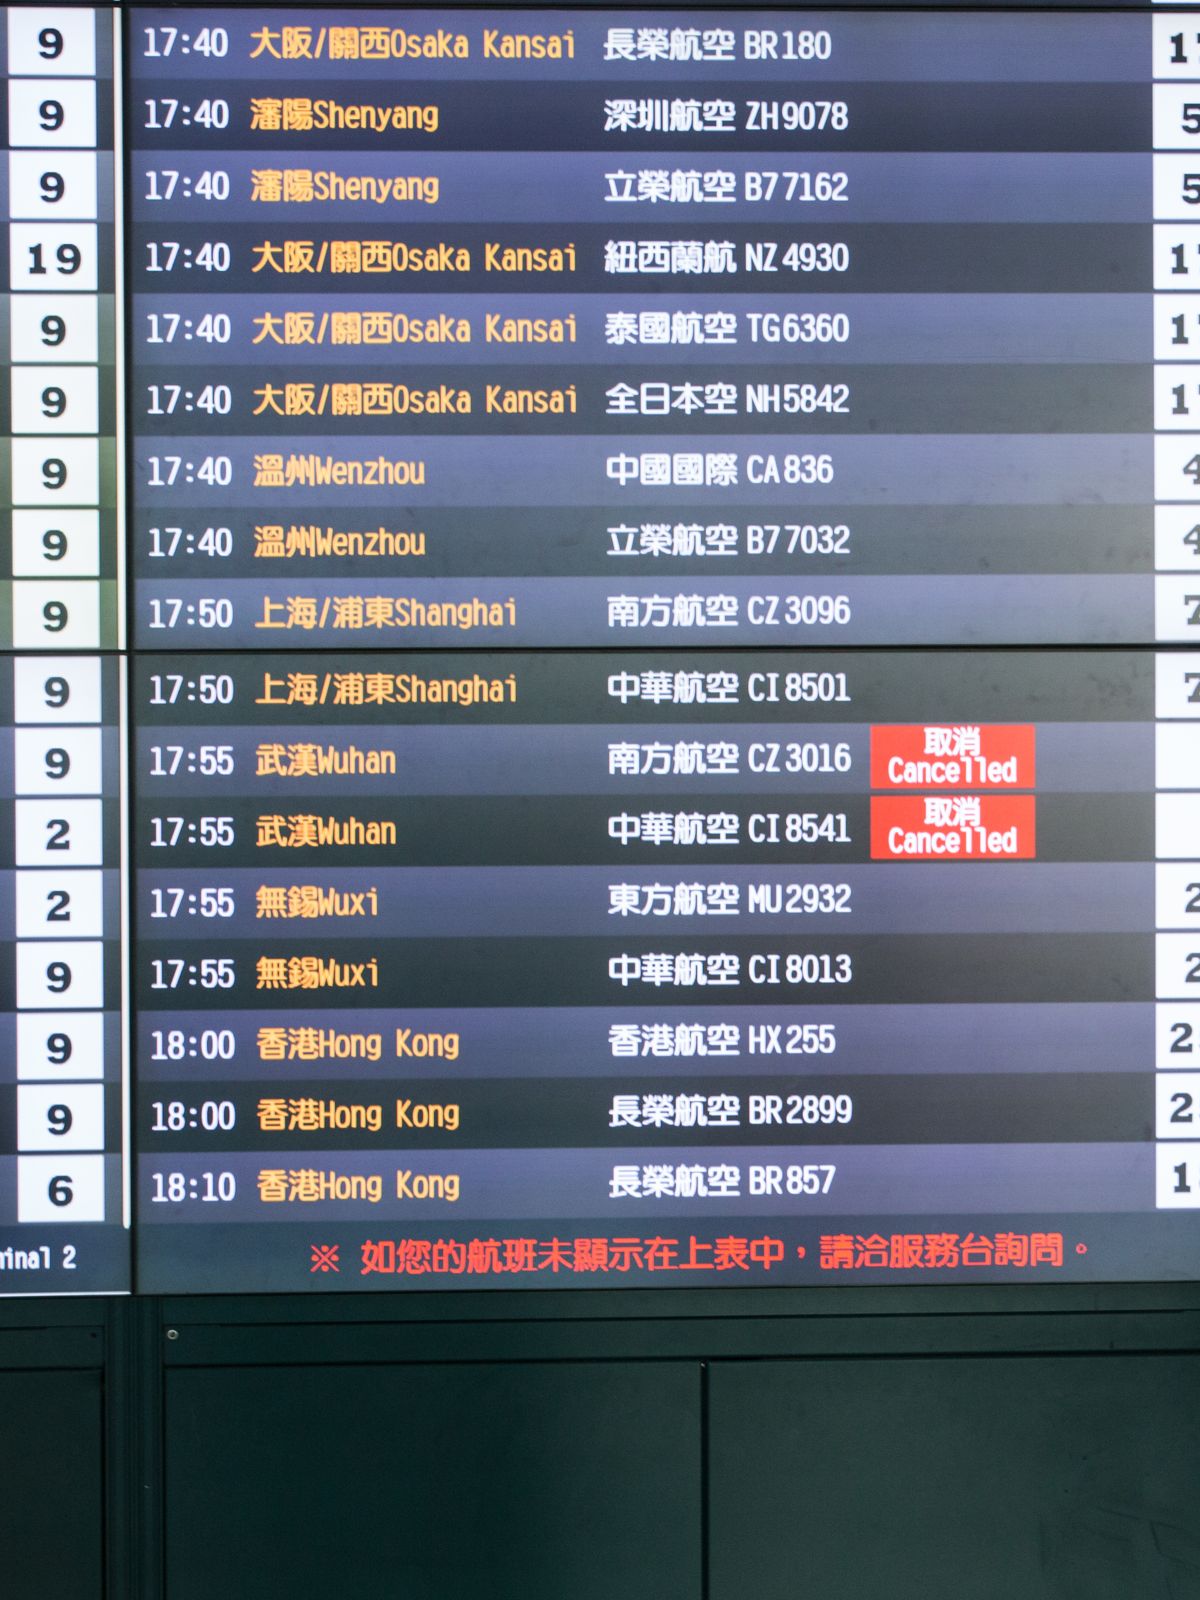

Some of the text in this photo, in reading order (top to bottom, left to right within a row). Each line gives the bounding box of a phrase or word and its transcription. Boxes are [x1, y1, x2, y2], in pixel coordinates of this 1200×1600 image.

[38, 27, 64, 60] 9
[144, 27, 229, 57] 17:40
[483, 30, 574, 59] Kansai
[603, 27, 736, 61] 長榮航空
[39, 99, 64, 131] 9
[145, 99, 229, 129] 17:40
[603, 98, 736, 132] 深圳航空
[40, 171, 65, 203] 9
[145, 170, 230, 201] 17:40
[604, 168, 737, 203] 立榮航空
[29, 243, 82, 275] 19
[146, 242, 231, 272] 17:40
[484, 243, 576, 272] Kansai
[604, 240, 737, 274] 紐西蘭航
[41, 315, 66, 347] 9
[146, 313, 231, 343] 17:40
[485, 314, 576, 343] Kansai
[604, 310, 738, 345] 泰國航空
[41, 386, 67, 418] 9
[147, 384, 232, 414] 17:40
[485, 384, 577, 414] Kansai
[605, 381, 738, 415] 全日本空
[42, 458, 67, 490] 9
[147, 456, 233, 486] 17:40
[606, 452, 739, 487] 中國國際
[42, 529, 68, 561] 9
[148, 527, 233, 557] 17:40
[606, 522, 739, 557] 立榮航空
[43, 601, 68, 632] 9
[149, 598, 234, 628] 17:50
[606, 593, 739, 628] 南方航空
[44, 676, 70, 708] 9
[150, 674, 234, 704] 17:50
[607, 670, 739, 704] 中華航空
[924, 726, 980, 757] 取消
[45, 748, 70, 779] 9
[150, 745, 234, 776] 17:55
[607, 740, 740, 775] 南方航空
[887, 756, 1018, 785] Cancelled
[924, 796, 980, 827] 取消
[46, 819, 70, 850] 2
[150, 816, 235, 847] 17:55
[608, 811, 740, 845] 中華航空
[887, 826, 1018, 855] Cancelled
[46, 890, 71, 922] 2
[150, 887, 235, 918] 17:55
[607, 881, 740, 917] 東方航空
[46, 961, 72, 993] 9
[151, 959, 235, 989] 17:55
[608, 952, 740, 987] 中華航空
[47, 1033, 72, 1065] 9
[151, 1029, 236, 1060] 18:00
[396, 1028, 459, 1060] Kong
[608, 1022, 741, 1057] 香港航空
[47, 1104, 73, 1136] 9
[151, 1101, 235, 1131] 18:00
[396, 1099, 460, 1131] Kong
[608, 1093, 741, 1128] 長榮航空
[48, 1175, 73, 1207] 6
[152, 1171, 236, 1202] 18:10
[397, 1171, 459, 1201] Kong
[608, 1163, 741, 1199] 長榮航空
[0, 1245, 76, 1269] inal 2
